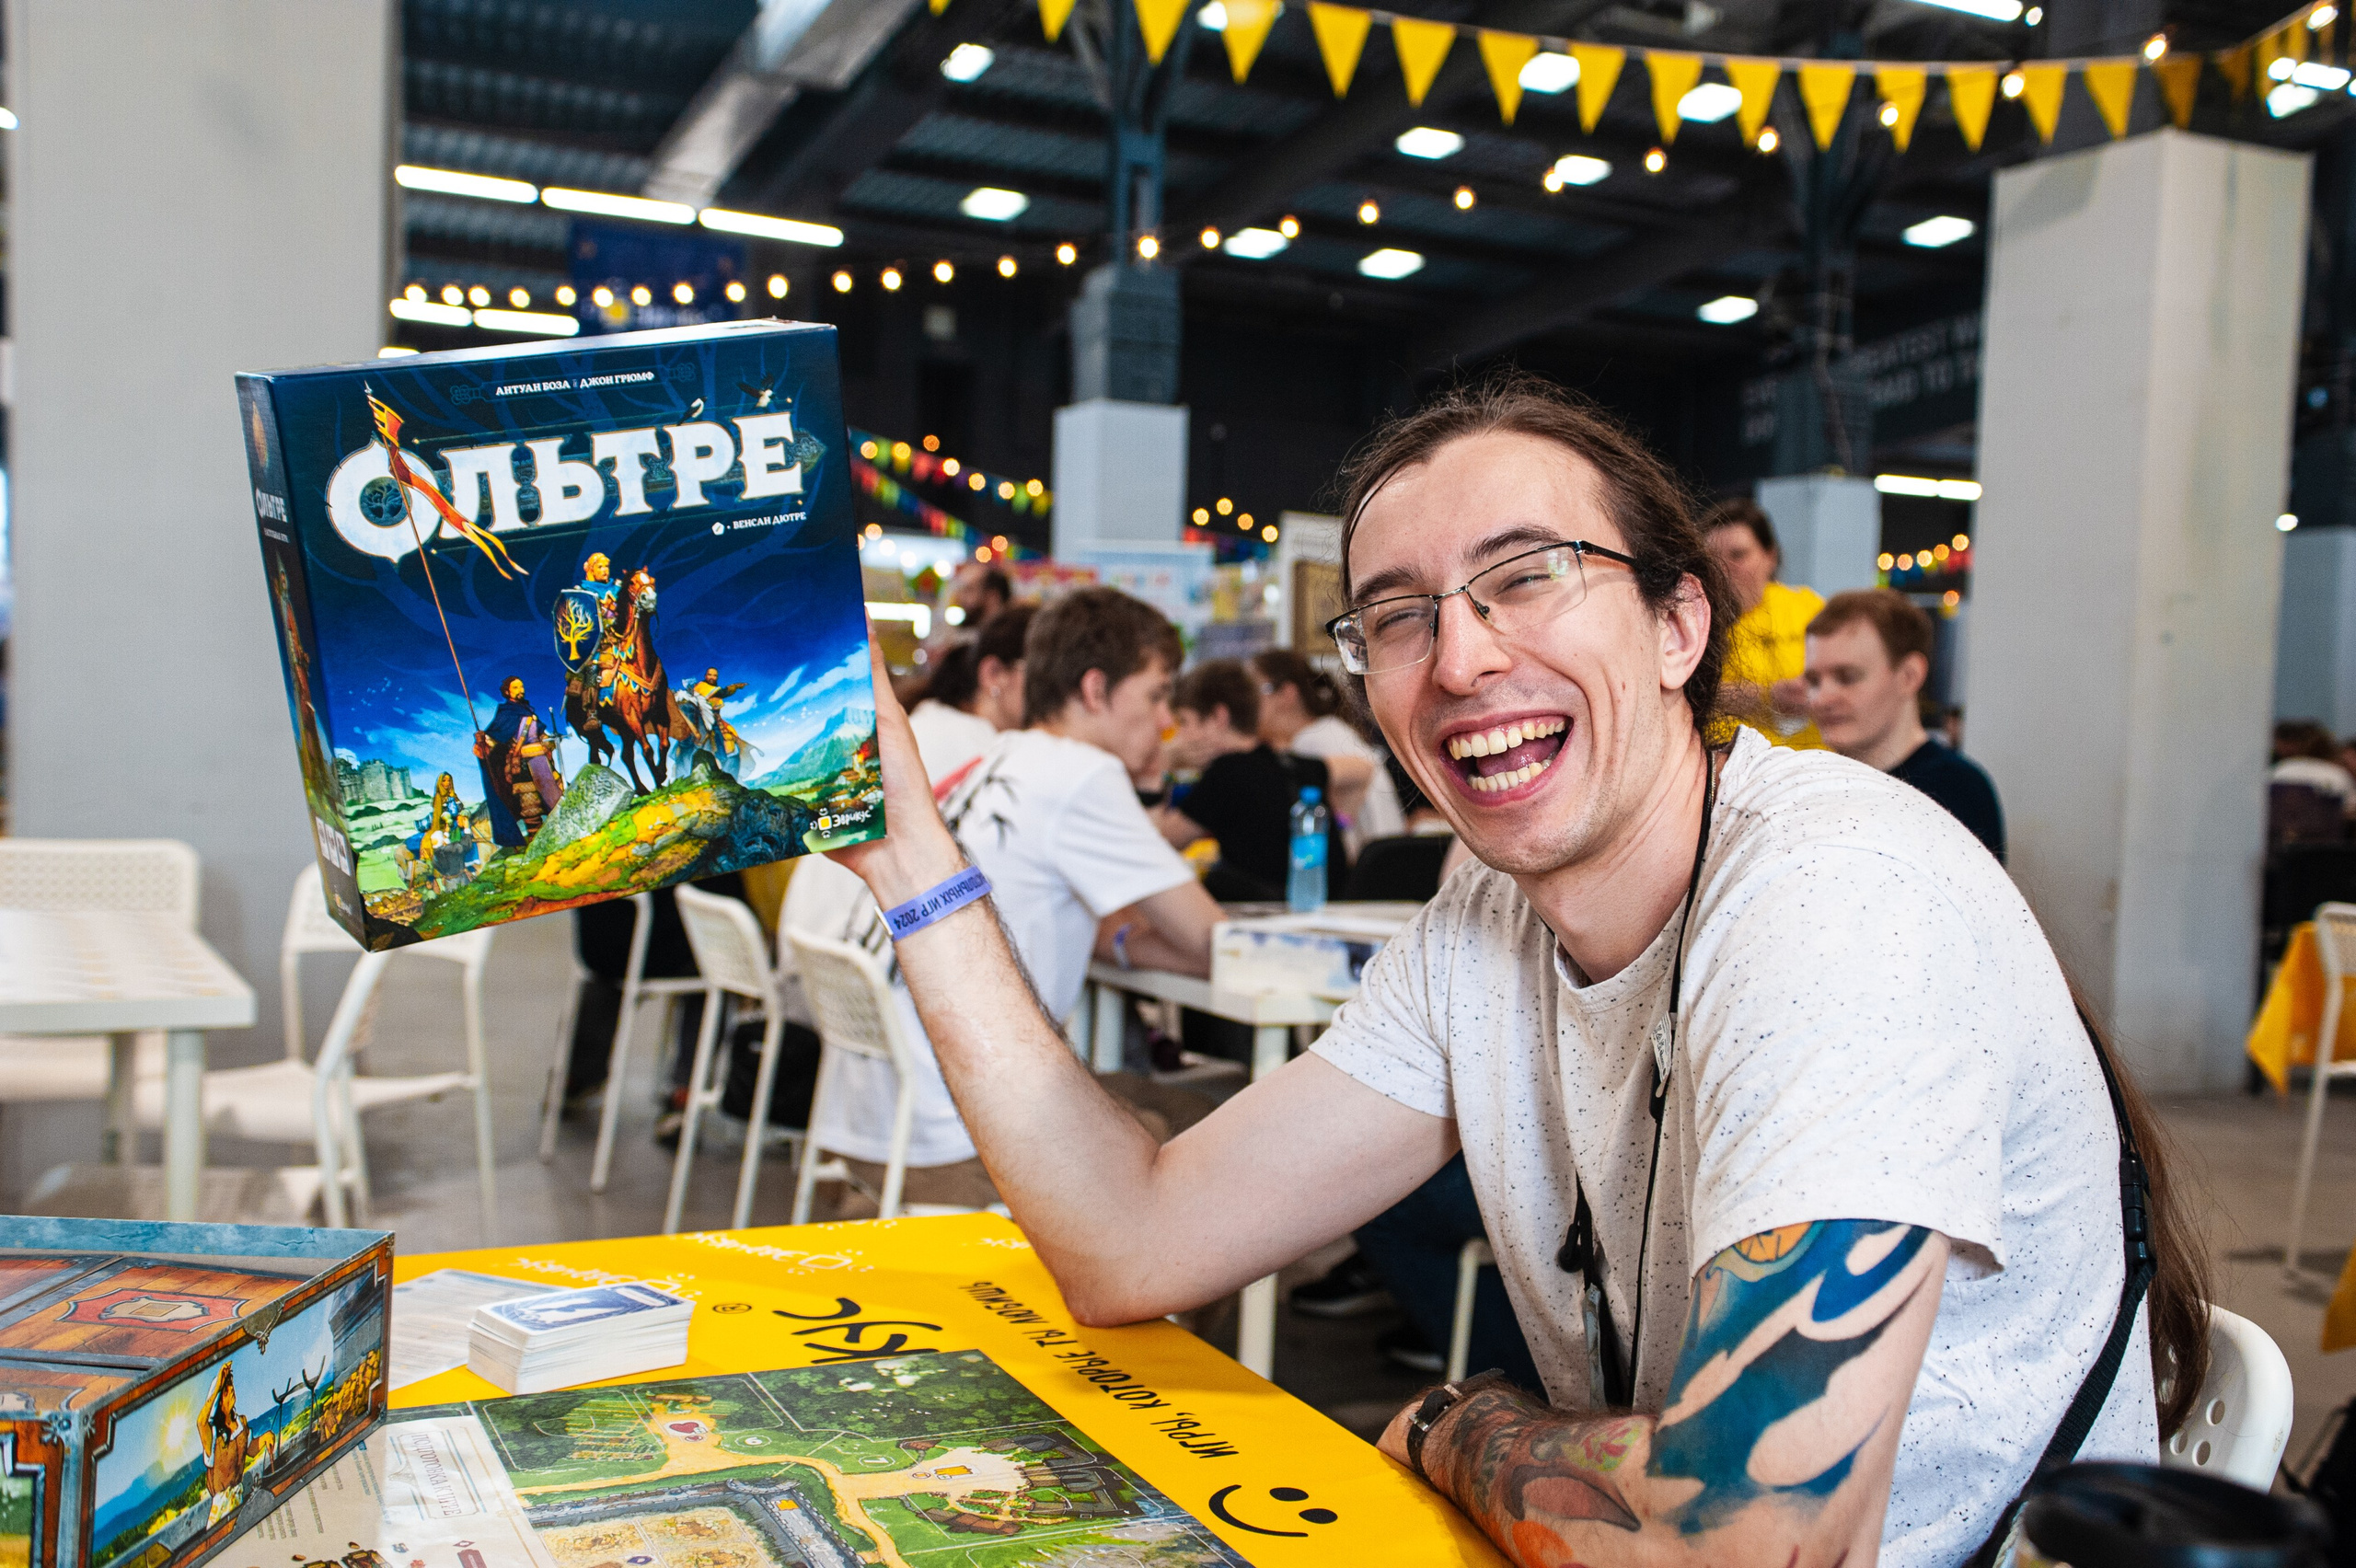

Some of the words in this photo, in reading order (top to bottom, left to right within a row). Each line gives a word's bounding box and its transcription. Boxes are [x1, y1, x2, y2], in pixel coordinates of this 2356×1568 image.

[495, 381, 542, 397] АНТУАН
[542, 379, 571, 391] БОЗА
[579, 374, 614, 388] ДЖОН
[614, 371, 655, 384] ГРЮМФ
[327, 411, 803, 564] ОЛЬТРЕ
[733, 515, 771, 530] ВЕНСАН
[771, 511, 807, 525] ДЮТРЕ
[921, 896, 942, 917] ИГР
[893, 908, 920, 930] 2024
[958, 1281, 1049, 1324] ЛЮБИШЬ
[1022, 1329, 1078, 1348] ТЫ
[1053, 1350, 1172, 1411] КОТОРЫЕ
[1149, 1412, 1240, 1459] ИГРЫ,
[436, 1493, 462, 1516] ИГРЕ
